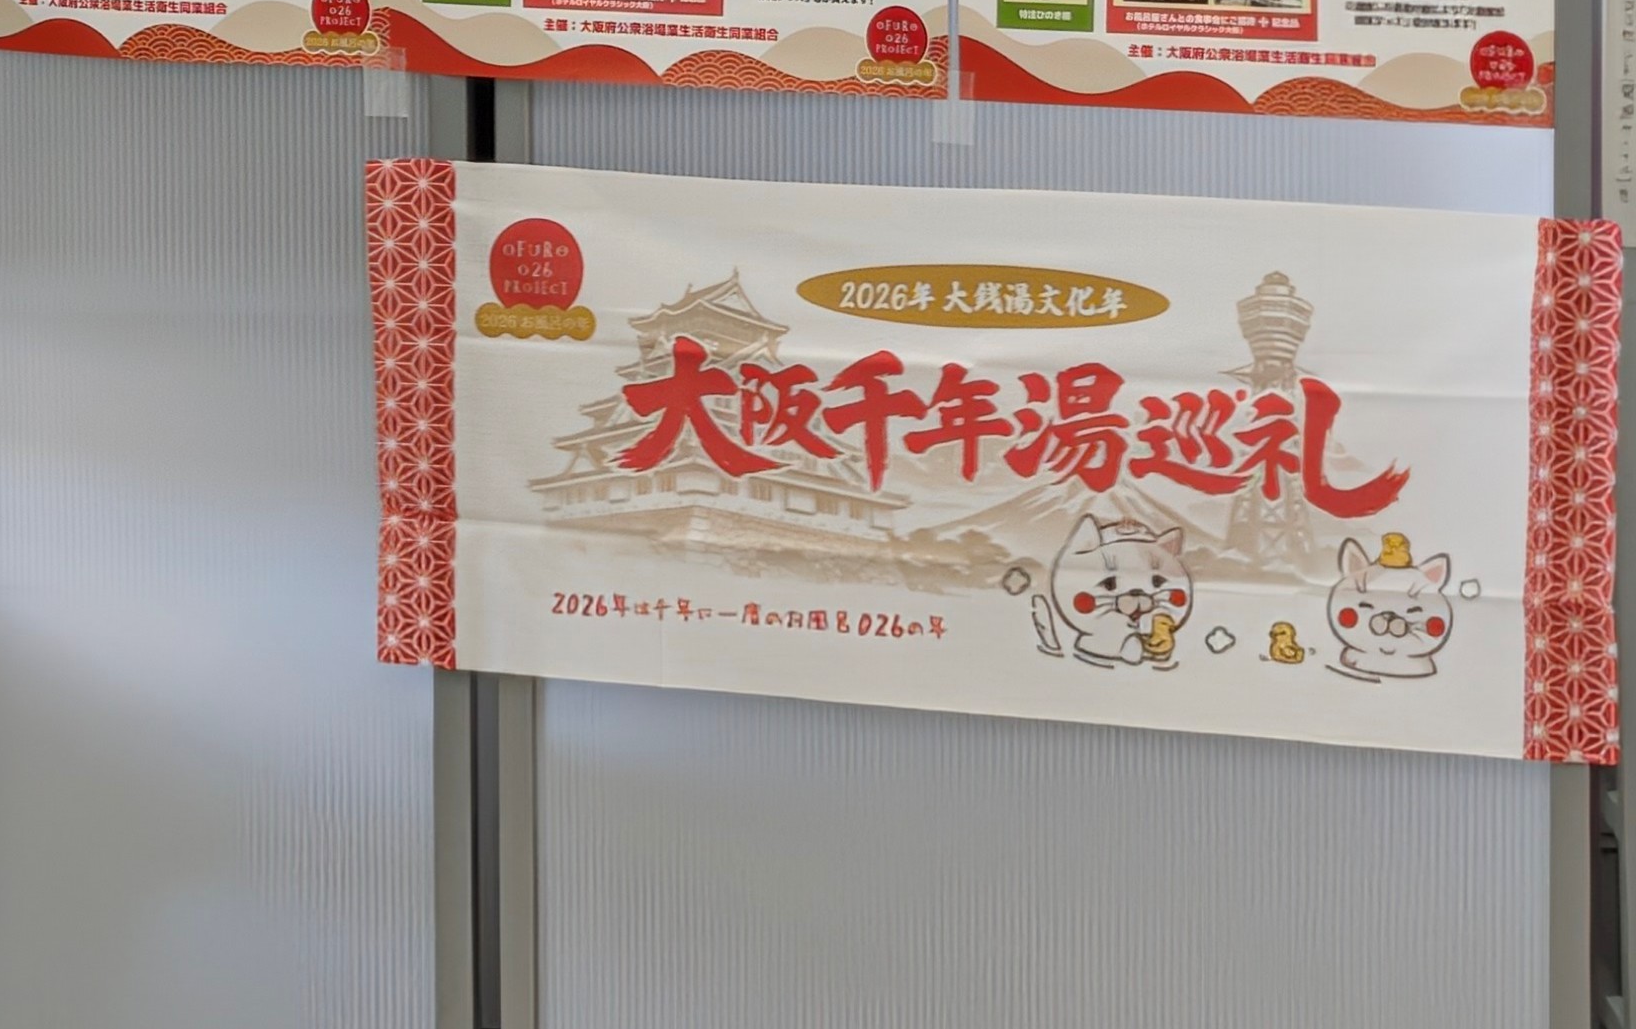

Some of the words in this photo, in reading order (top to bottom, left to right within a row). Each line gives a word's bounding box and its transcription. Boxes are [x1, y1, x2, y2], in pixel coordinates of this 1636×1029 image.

[839, 281, 936, 311] 2026年
[942, 281, 1127, 319] 大銭湯文化年
[610, 336, 1410, 518] 大阪千年湯巡礼
